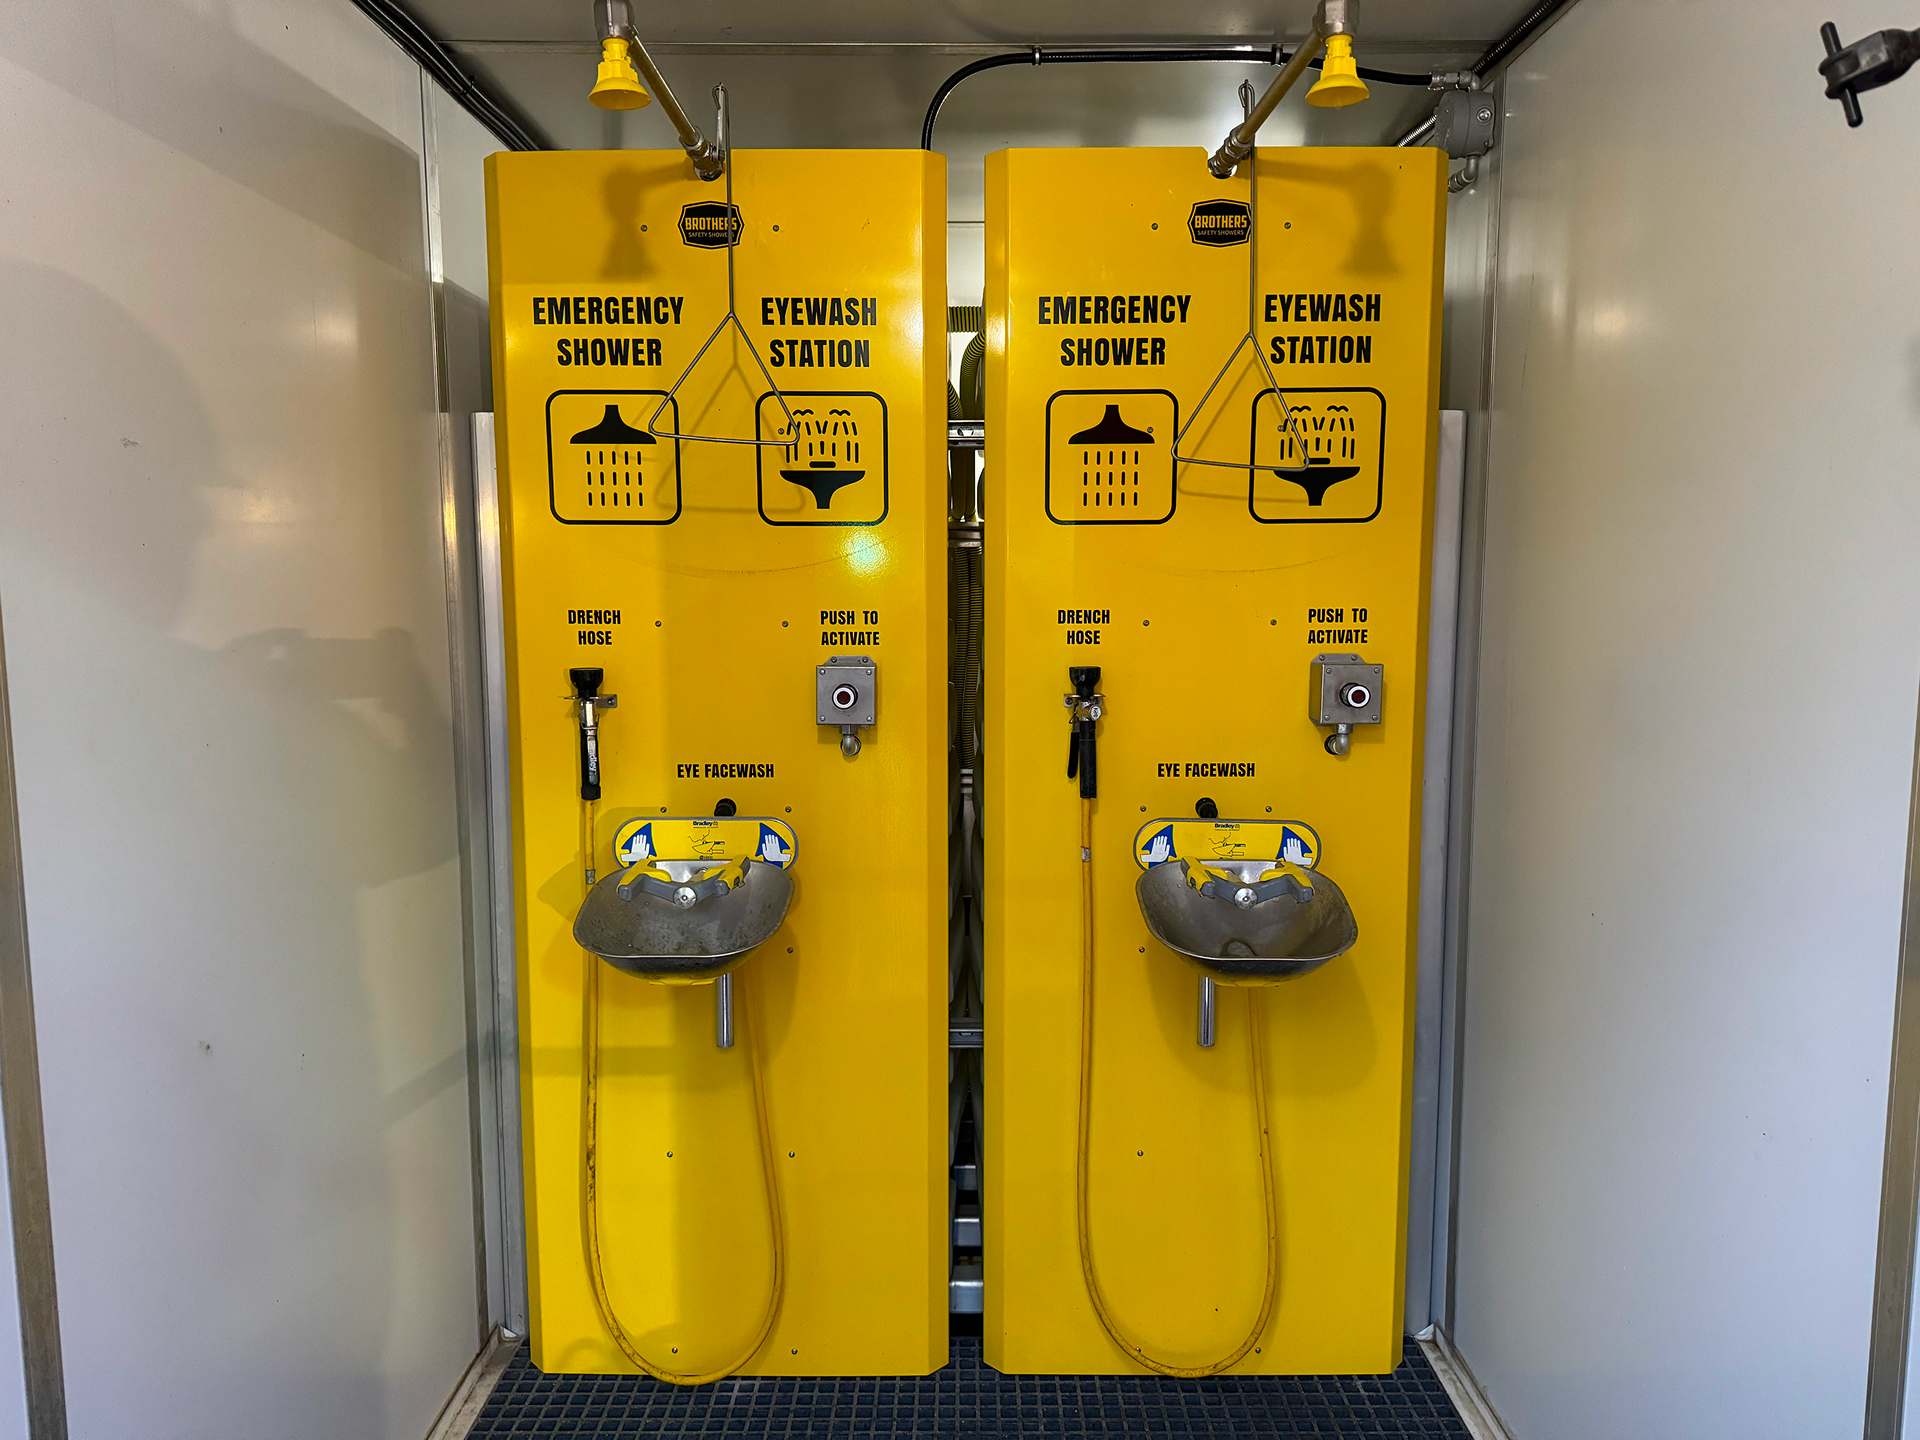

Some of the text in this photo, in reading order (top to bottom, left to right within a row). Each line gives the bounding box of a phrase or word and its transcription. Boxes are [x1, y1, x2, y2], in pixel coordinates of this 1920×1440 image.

[1194, 215, 1248, 229] BROTHERS
[532, 296, 684, 325] EMERGENCY
[761, 297, 877, 326] EYEWASH
[1038, 294, 1192, 325] EMERGENCY
[1264, 293, 1381, 323] EYEWASH
[557, 338, 662, 367] SHOWER
[770, 339, 870, 368] STATION
[1060, 337, 1166, 367] SHOWER
[1269, 335, 1372, 364] STATION
[567, 609, 621, 625] DRENCH
[820, 610, 879, 626] PUSH TO
[1057, 609, 1110, 625] DRENCH
[1308, 608, 1368, 624] PUSH TO
[578, 630, 613, 646] HOSE
[821, 631, 880, 646] ACTIVATE
[1066, 630, 1101, 645] HOSE
[1307, 629, 1368, 645] ACTIVATE
[677, 763, 775, 779] EYE FACEWASH
[1157, 762, 1256, 778] EYE FACEWASH
